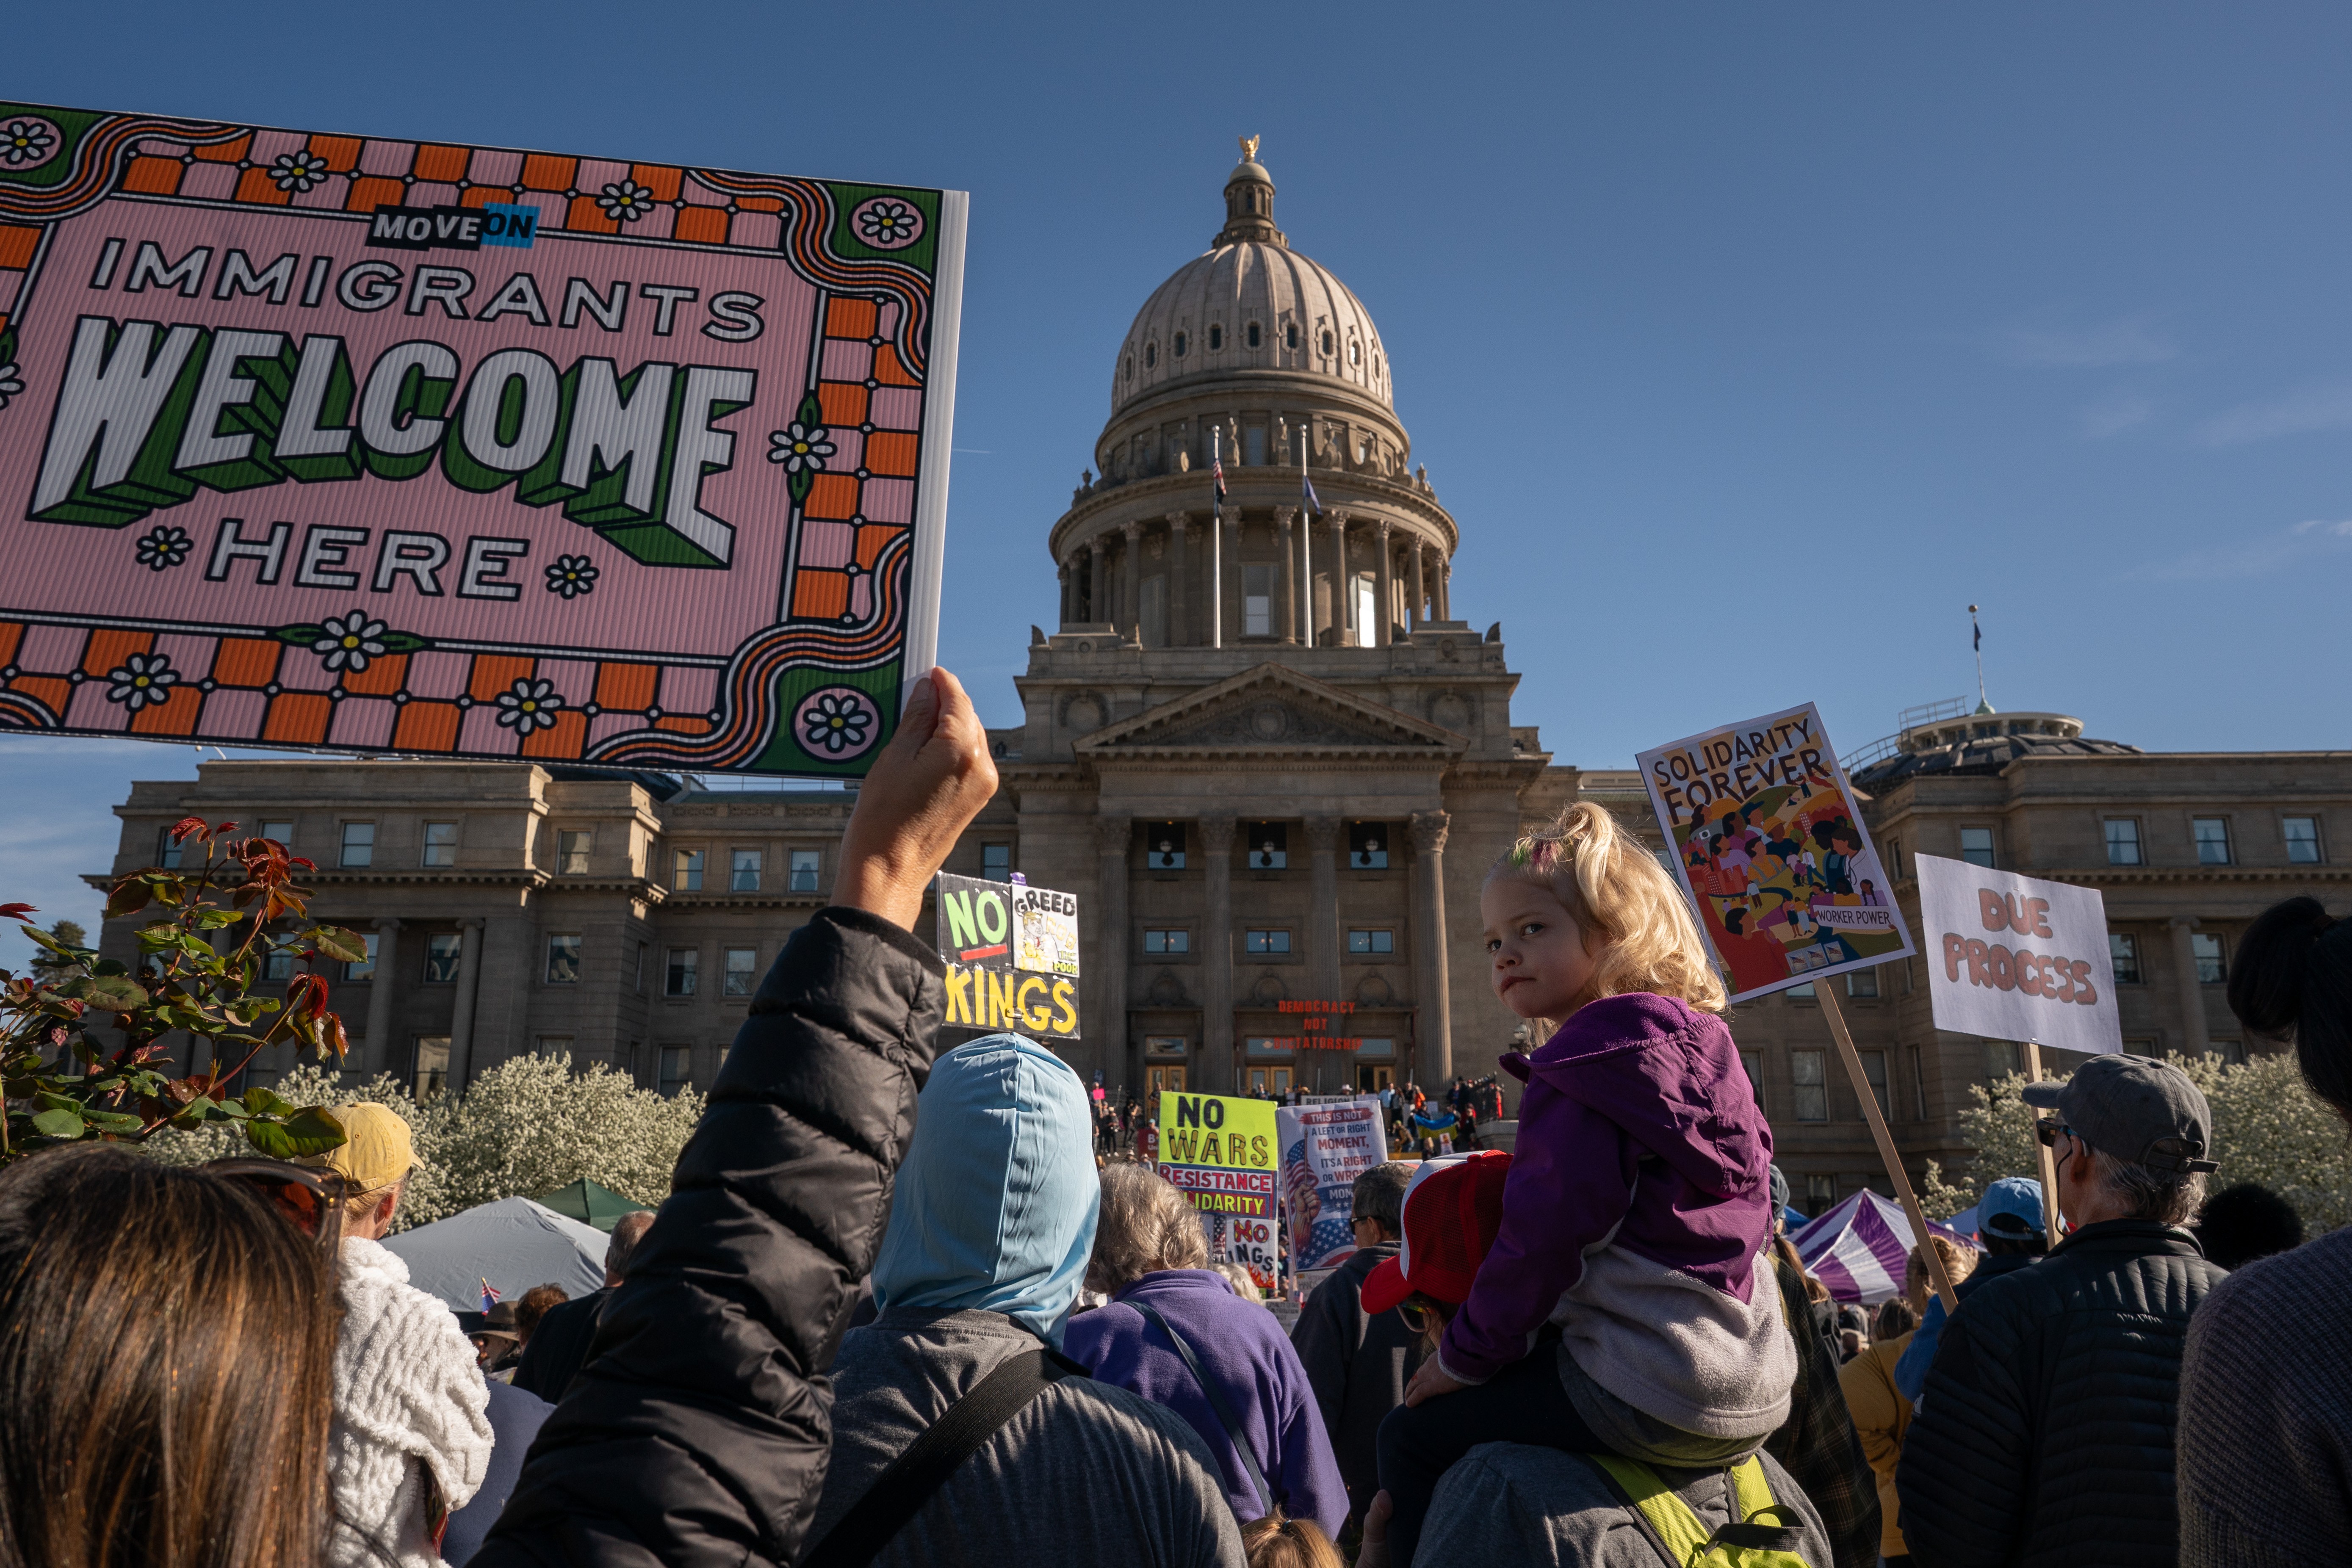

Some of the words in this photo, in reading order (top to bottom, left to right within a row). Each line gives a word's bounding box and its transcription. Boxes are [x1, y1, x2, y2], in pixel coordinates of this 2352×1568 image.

[88, 238, 766, 341] IMMIGRANTS
[25, 313, 758, 570] WELCOME
[204, 518, 530, 602] HERE
[1654, 718, 1811, 787] SOLIDARITY
[1664, 749, 1831, 825] FOREVER
[1015, 890, 1075, 917] GREED
[1978, 888, 2053, 939] DUE
[944, 890, 1007, 948] NO
[1817, 910, 1854, 924] WORKER
[1856, 911, 1891, 925] POWER
[1046, 915, 1077, 950] ROB
[1053, 961, 1078, 974] POOR
[1942, 932, 2097, 1005] PROCESS
[945, 964, 1076, 1033] KINGS
[1278, 1000, 1355, 1014] DEMOCRACY
[1304, 1018, 1327, 1030] NOT
[1273, 1037, 1363, 1050] DICTATORSHIP
[1178, 1096, 1224, 1129] NO
[1310, 1113, 1331, 1122] THIS
[1334, 1112, 1342, 1121] IS
[1344, 1111, 1362, 1120] NOT
[1312, 1128, 1317, 1136] A
[1318, 1127, 1335, 1135] LEFT
[1347, 1124, 1370, 1133] RIGHT
[1318, 1136, 1369, 1150] MOMENT,
[1168, 1128, 1269, 1166] WARS
[1321, 1158, 1336, 1168] IT'S
[1336, 1158, 1342, 1167] A
[1343, 1155, 1372, 1167] RIGHT
[1160, 1165, 1270, 1192] RESISTANCE
[1183, 1191, 1264, 1214] LIDARITY
[1234, 1219, 1270, 1243] NO
[1228, 1244, 1273, 1272] INGS
